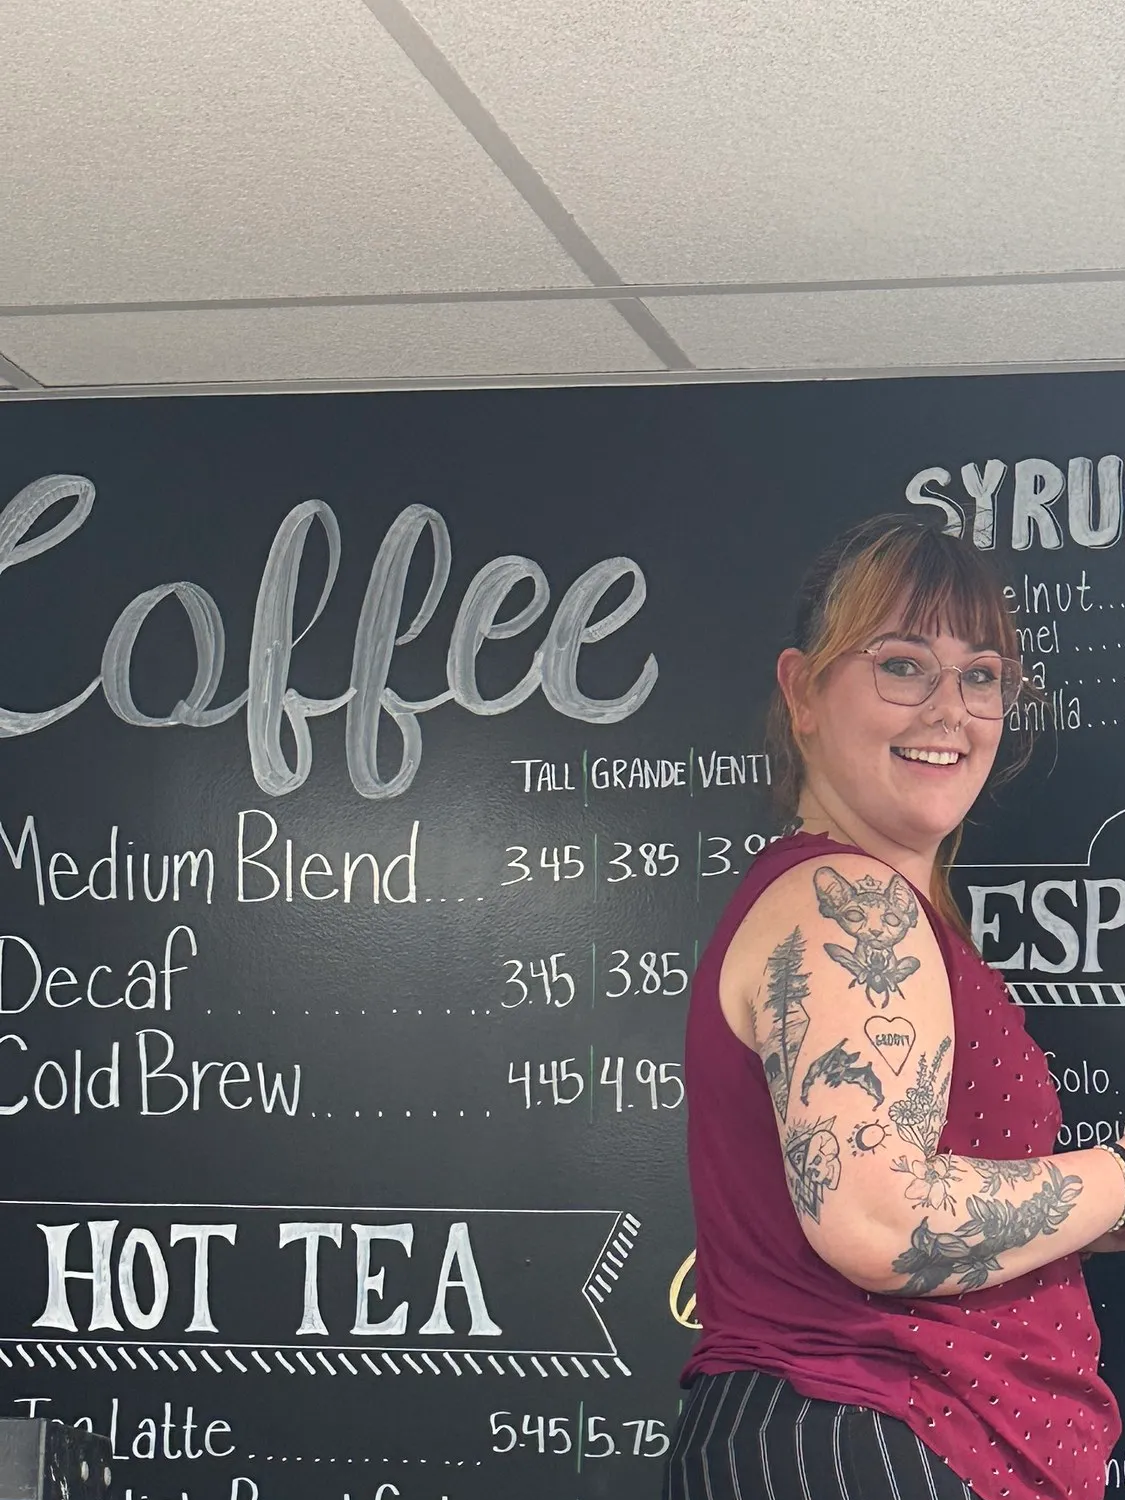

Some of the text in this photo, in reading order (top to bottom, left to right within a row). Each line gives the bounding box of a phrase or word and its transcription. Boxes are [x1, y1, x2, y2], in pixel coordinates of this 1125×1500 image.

[511, 750, 772, 792] TALL GRANDE VENTI
[0, 815, 214, 905] Medium
[238, 809, 420, 903] Blend
[501, 846, 585, 886] 3.45
[607, 843, 680, 882] 3.85
[0, 925, 688, 1014] Decaf 3.45 3.85
[507, 1058, 585, 1109] 4.45
[600, 1056, 685, 1112] 4.95
[32, 1220, 502, 1337] HOT TEA
[111, 1398, 236, 1460] Latte
[490, 1411, 572, 1454] 5.45
[584, 1416, 671, 1458] 5.75
